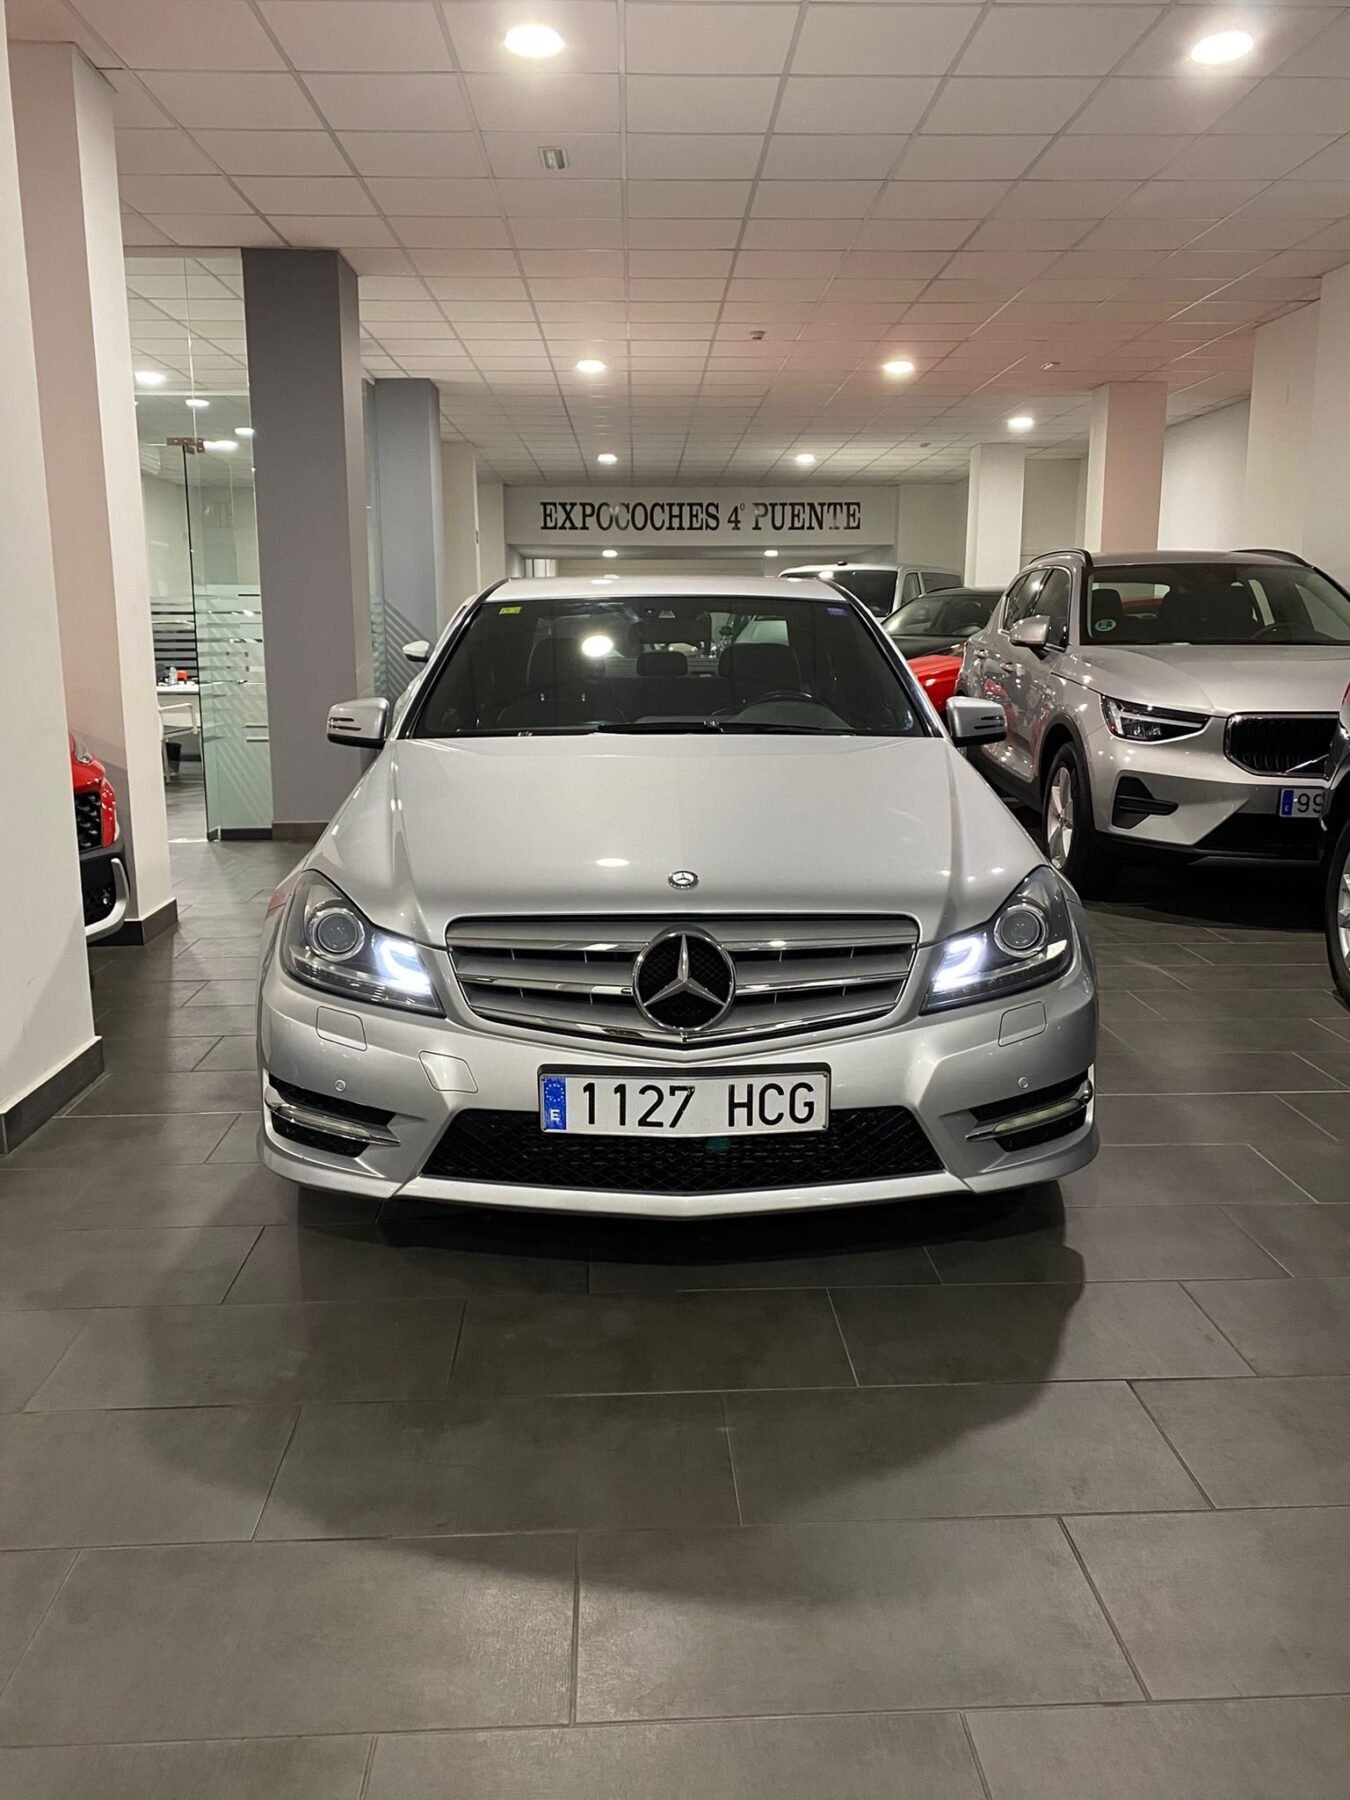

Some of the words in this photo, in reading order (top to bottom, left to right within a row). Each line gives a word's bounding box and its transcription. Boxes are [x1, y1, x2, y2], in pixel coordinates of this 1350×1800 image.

[540, 502, 720, 532] EXPOCOCHES
[752, 502, 861, 532] PUENTE
[550, 1109, 561, 1124] E
[583, 1082, 695, 1129] 1127
[728, 1082, 815, 1128] HCG
